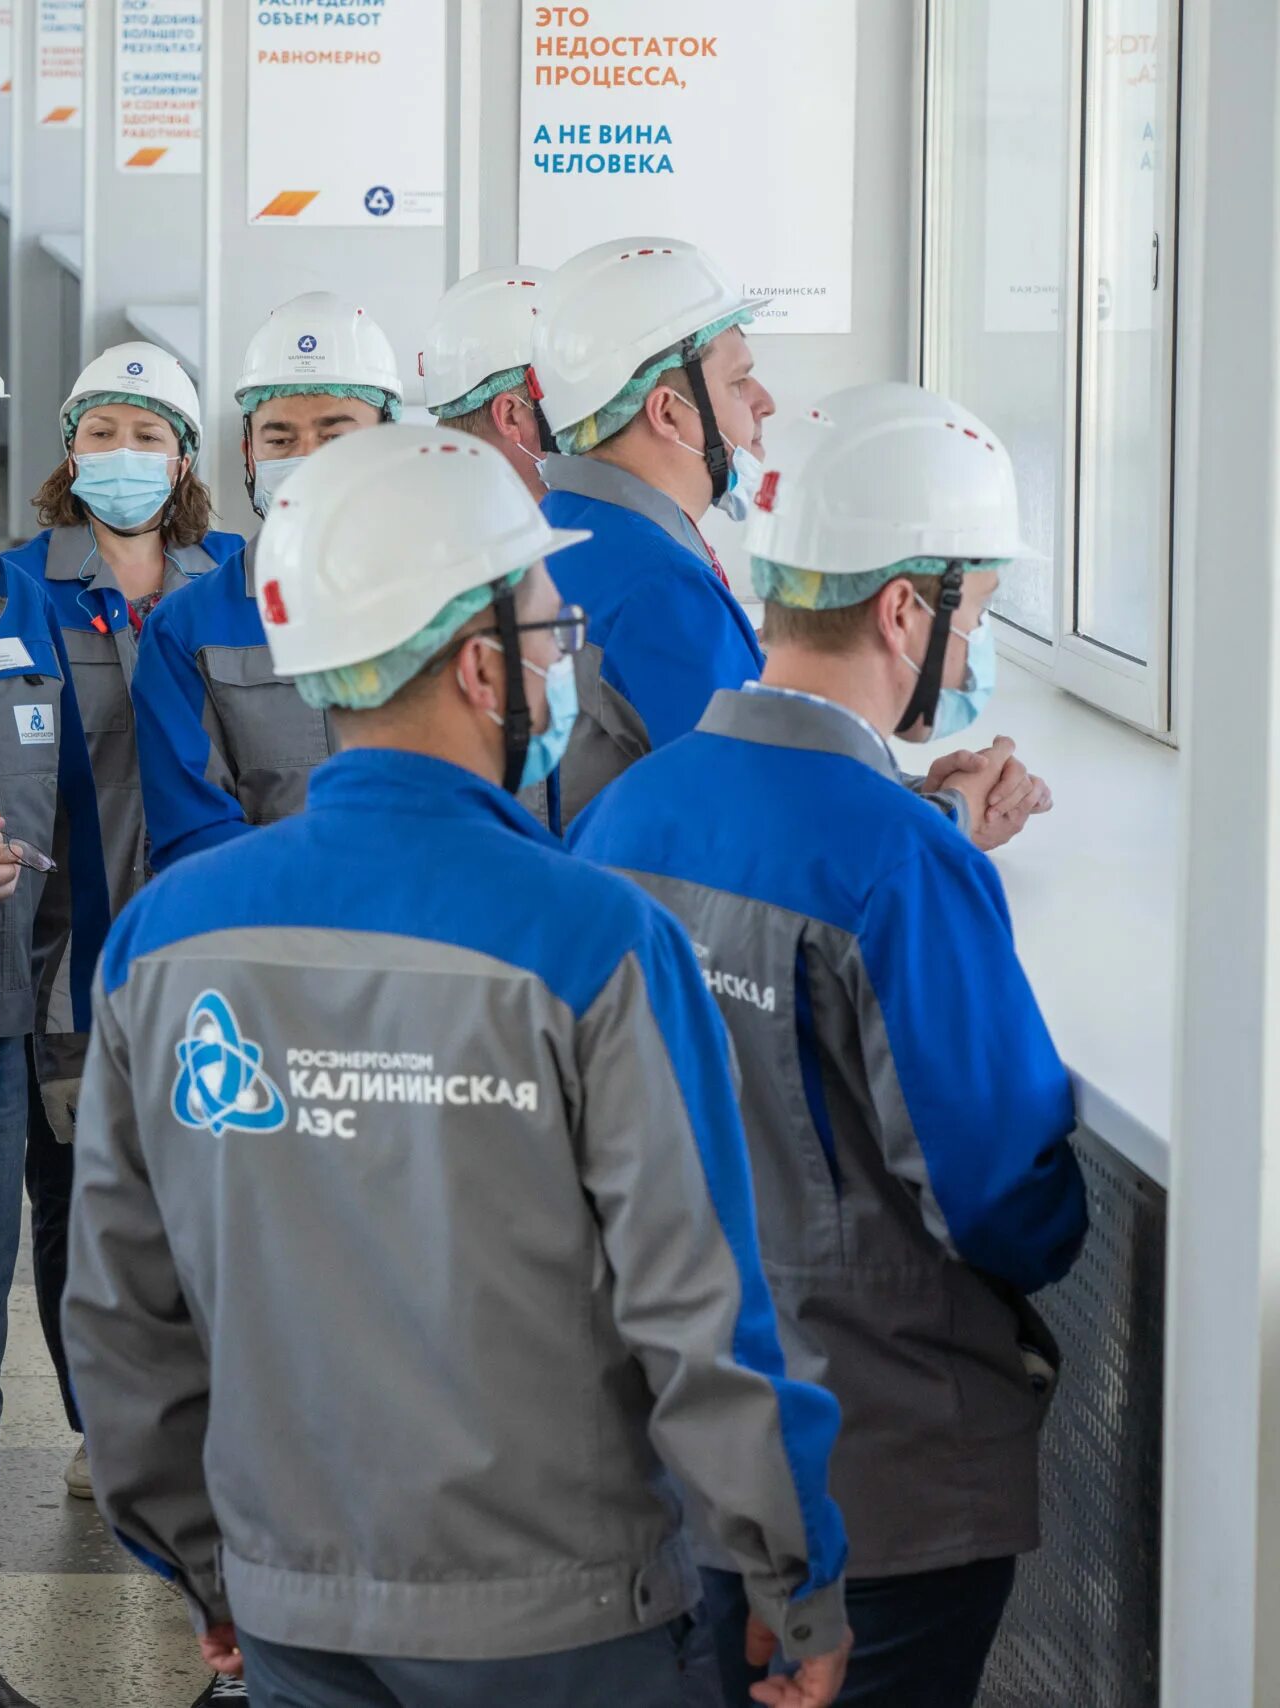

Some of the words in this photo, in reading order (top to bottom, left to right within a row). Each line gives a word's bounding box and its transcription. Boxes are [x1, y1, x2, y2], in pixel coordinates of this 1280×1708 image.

[258, 12, 319, 26] ОБЪЕМ
[323, 12, 381, 26] РАБОТ
[535, 7, 590, 27] ЭТО
[257, 50, 382, 64] РАВНОМЕРНО
[536, 36, 718, 59] НЕДОСТАТОК
[535, 66, 687, 89] ПРОЦЕССА,
[533, 124, 552, 144] А
[559, 124, 591, 144] НЕ
[599, 124, 673, 144] ВИНА
[534, 153, 675, 174] ЧЕЛОВЕКА
[749, 287, 827, 297] КАЛИНИНСКАЯ
[752, 310, 788, 318] ОСАТОМ
[703, 969, 775, 1013] НСКАЯ
[286, 1048, 434, 1071] РОСЭНЕРГОАТОМ
[288, 1069, 539, 1111] КАЛИНИНСКАЯ
[296, 1106, 357, 1139] АЭС
